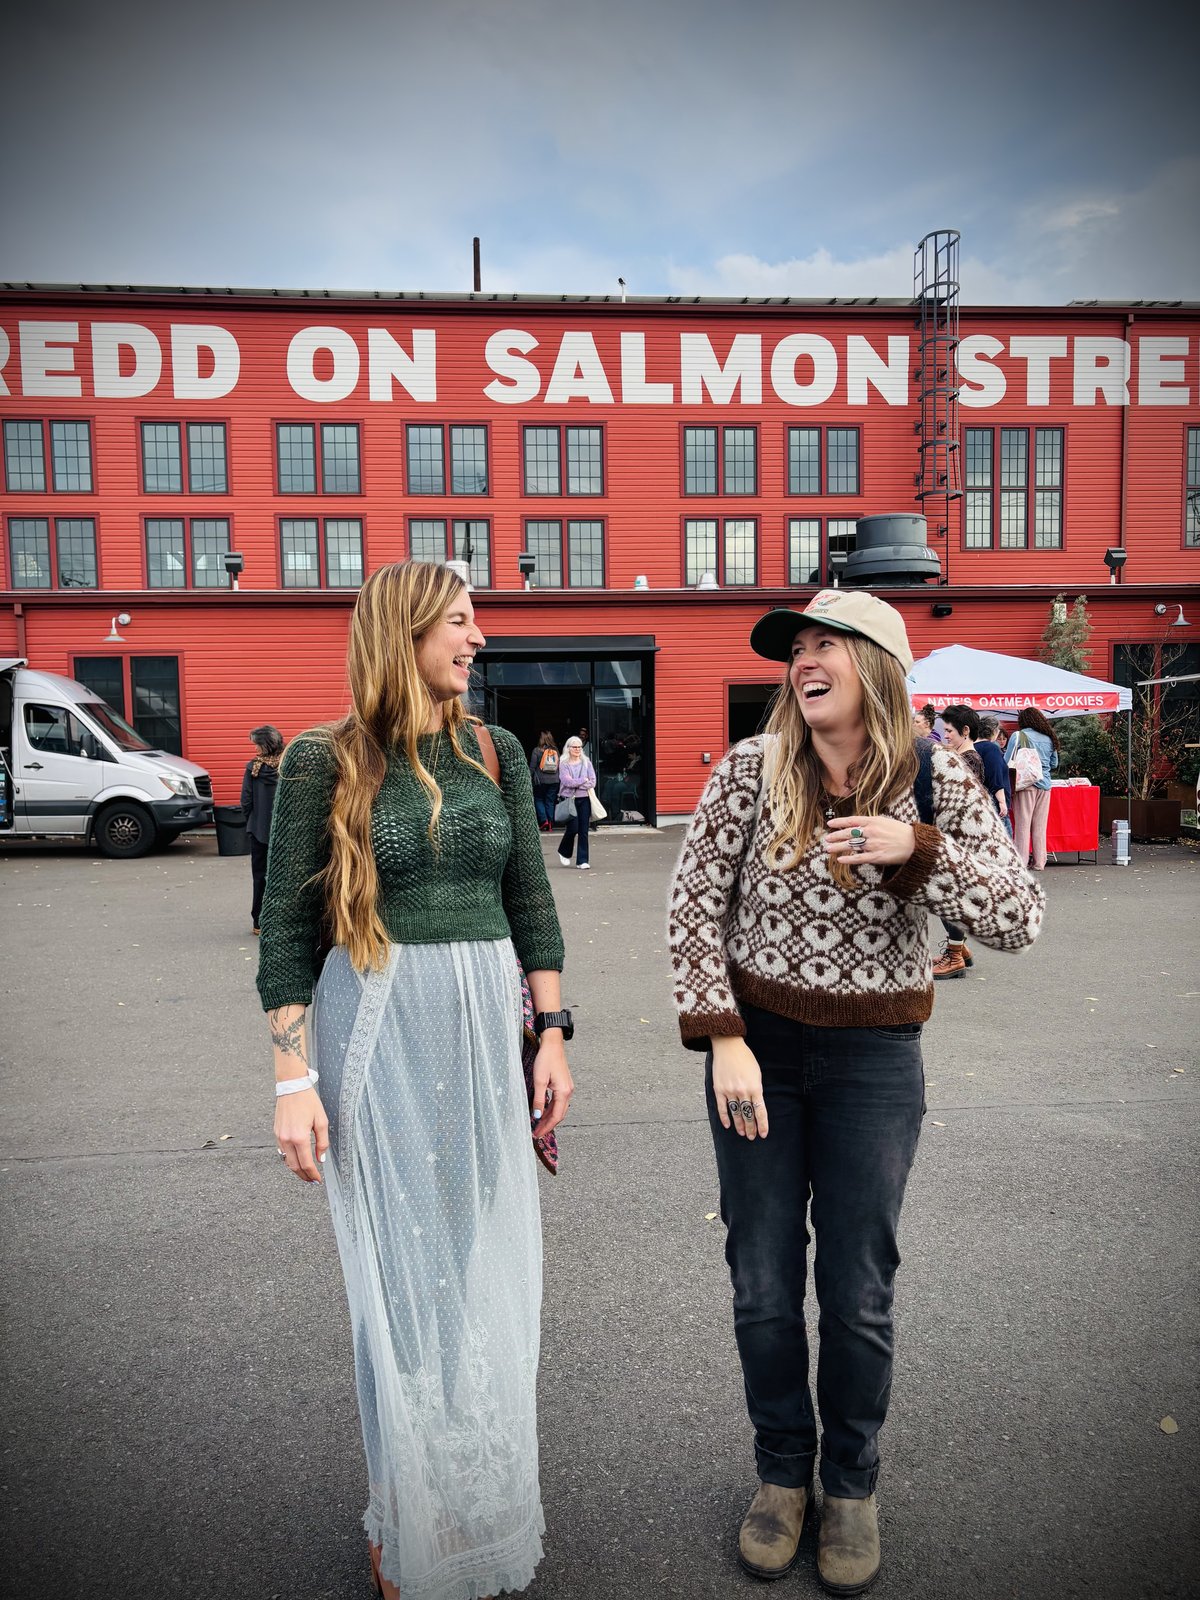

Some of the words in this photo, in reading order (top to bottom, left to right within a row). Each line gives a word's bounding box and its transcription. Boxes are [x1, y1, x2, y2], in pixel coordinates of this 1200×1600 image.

[0, 320, 241, 399] EDD
[286, 325, 437, 403] ON
[482, 328, 910, 407] SALMON
[954, 333, 1200, 408] STRE
[927, 696, 973, 707] NATE'S
[978, 696, 1040, 708] OATMEAL
[1046, 695, 1105, 707] COOKIES
